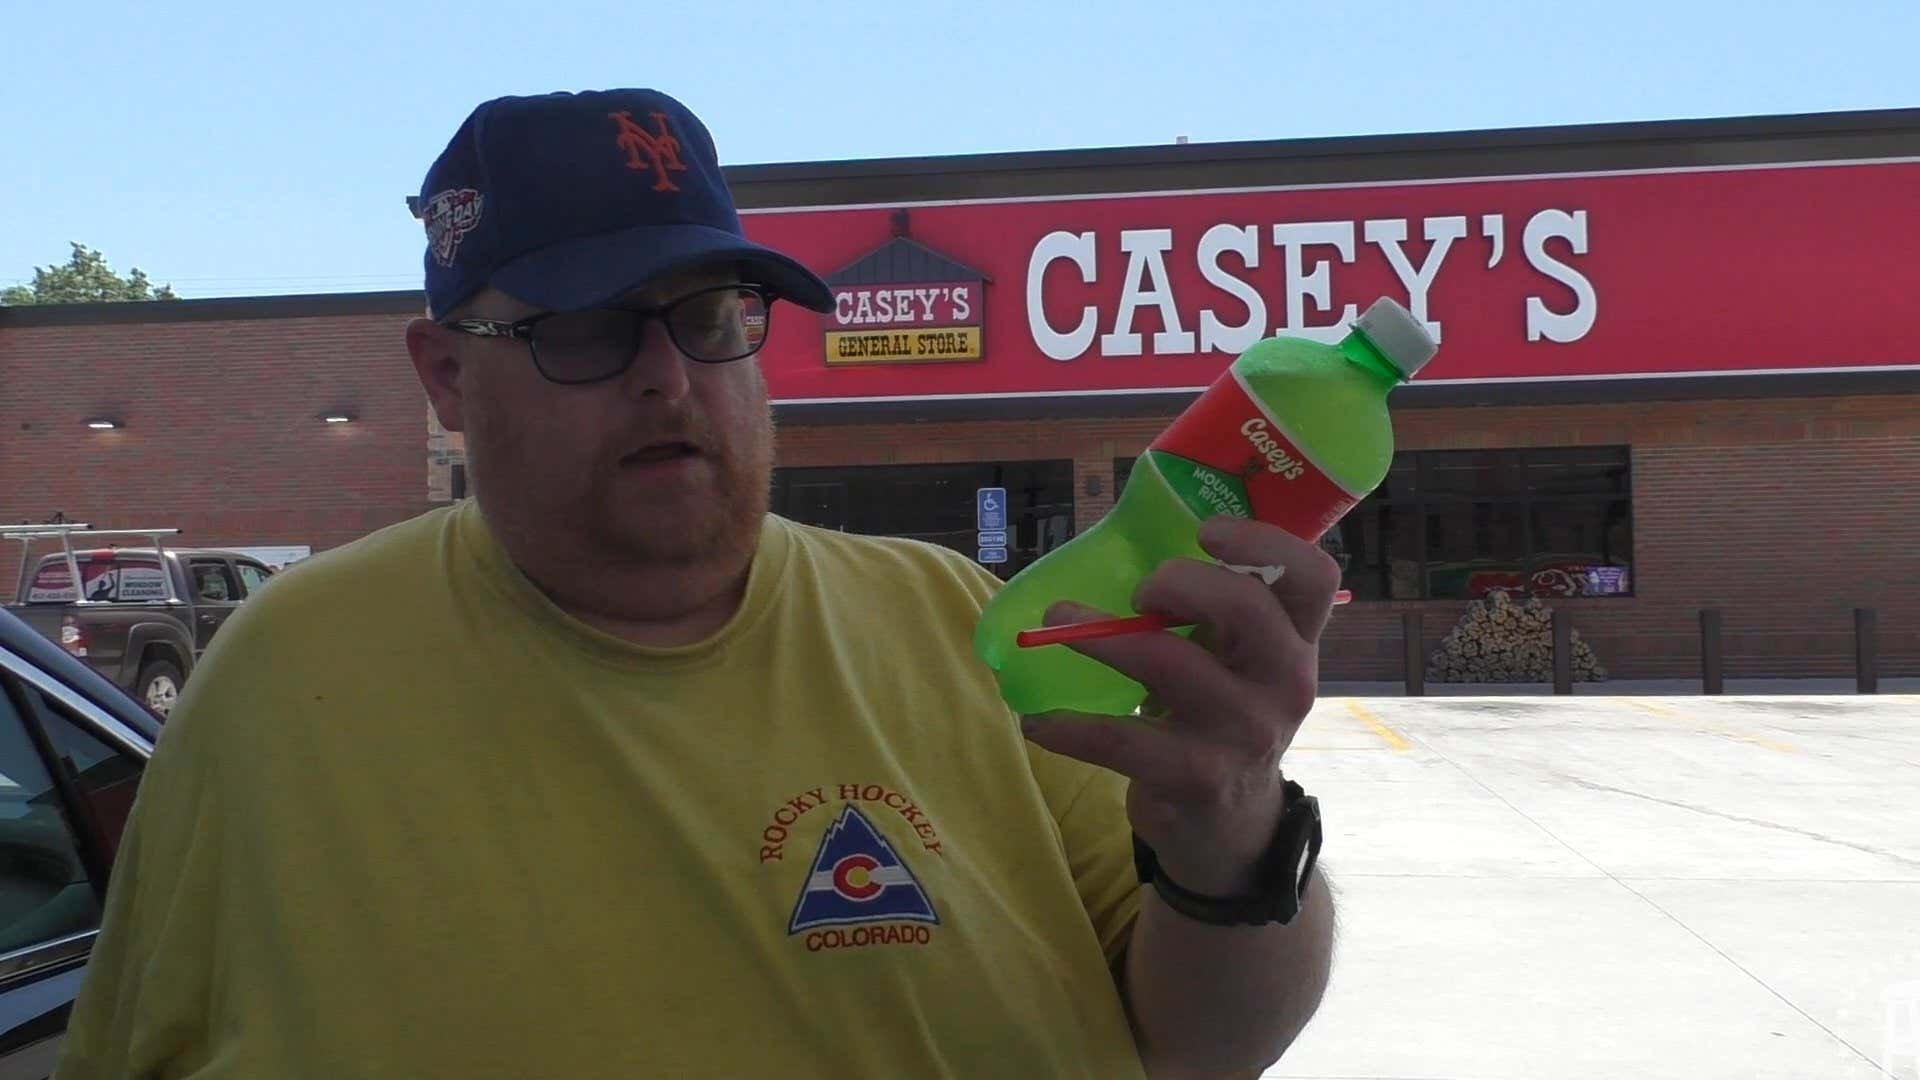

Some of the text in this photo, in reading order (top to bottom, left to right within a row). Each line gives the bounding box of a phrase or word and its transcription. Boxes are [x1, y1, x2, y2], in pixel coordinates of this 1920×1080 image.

[835, 287, 970, 324] CASEY'S
[1027, 209, 1597, 361] CASEY'S
[838, 333, 912, 357] GENERAL
[1241, 418, 1304, 480] Casey's
[760, 784, 944, 864] ROCKY HOCKEY
[806, 925, 930, 951] COLORADO
